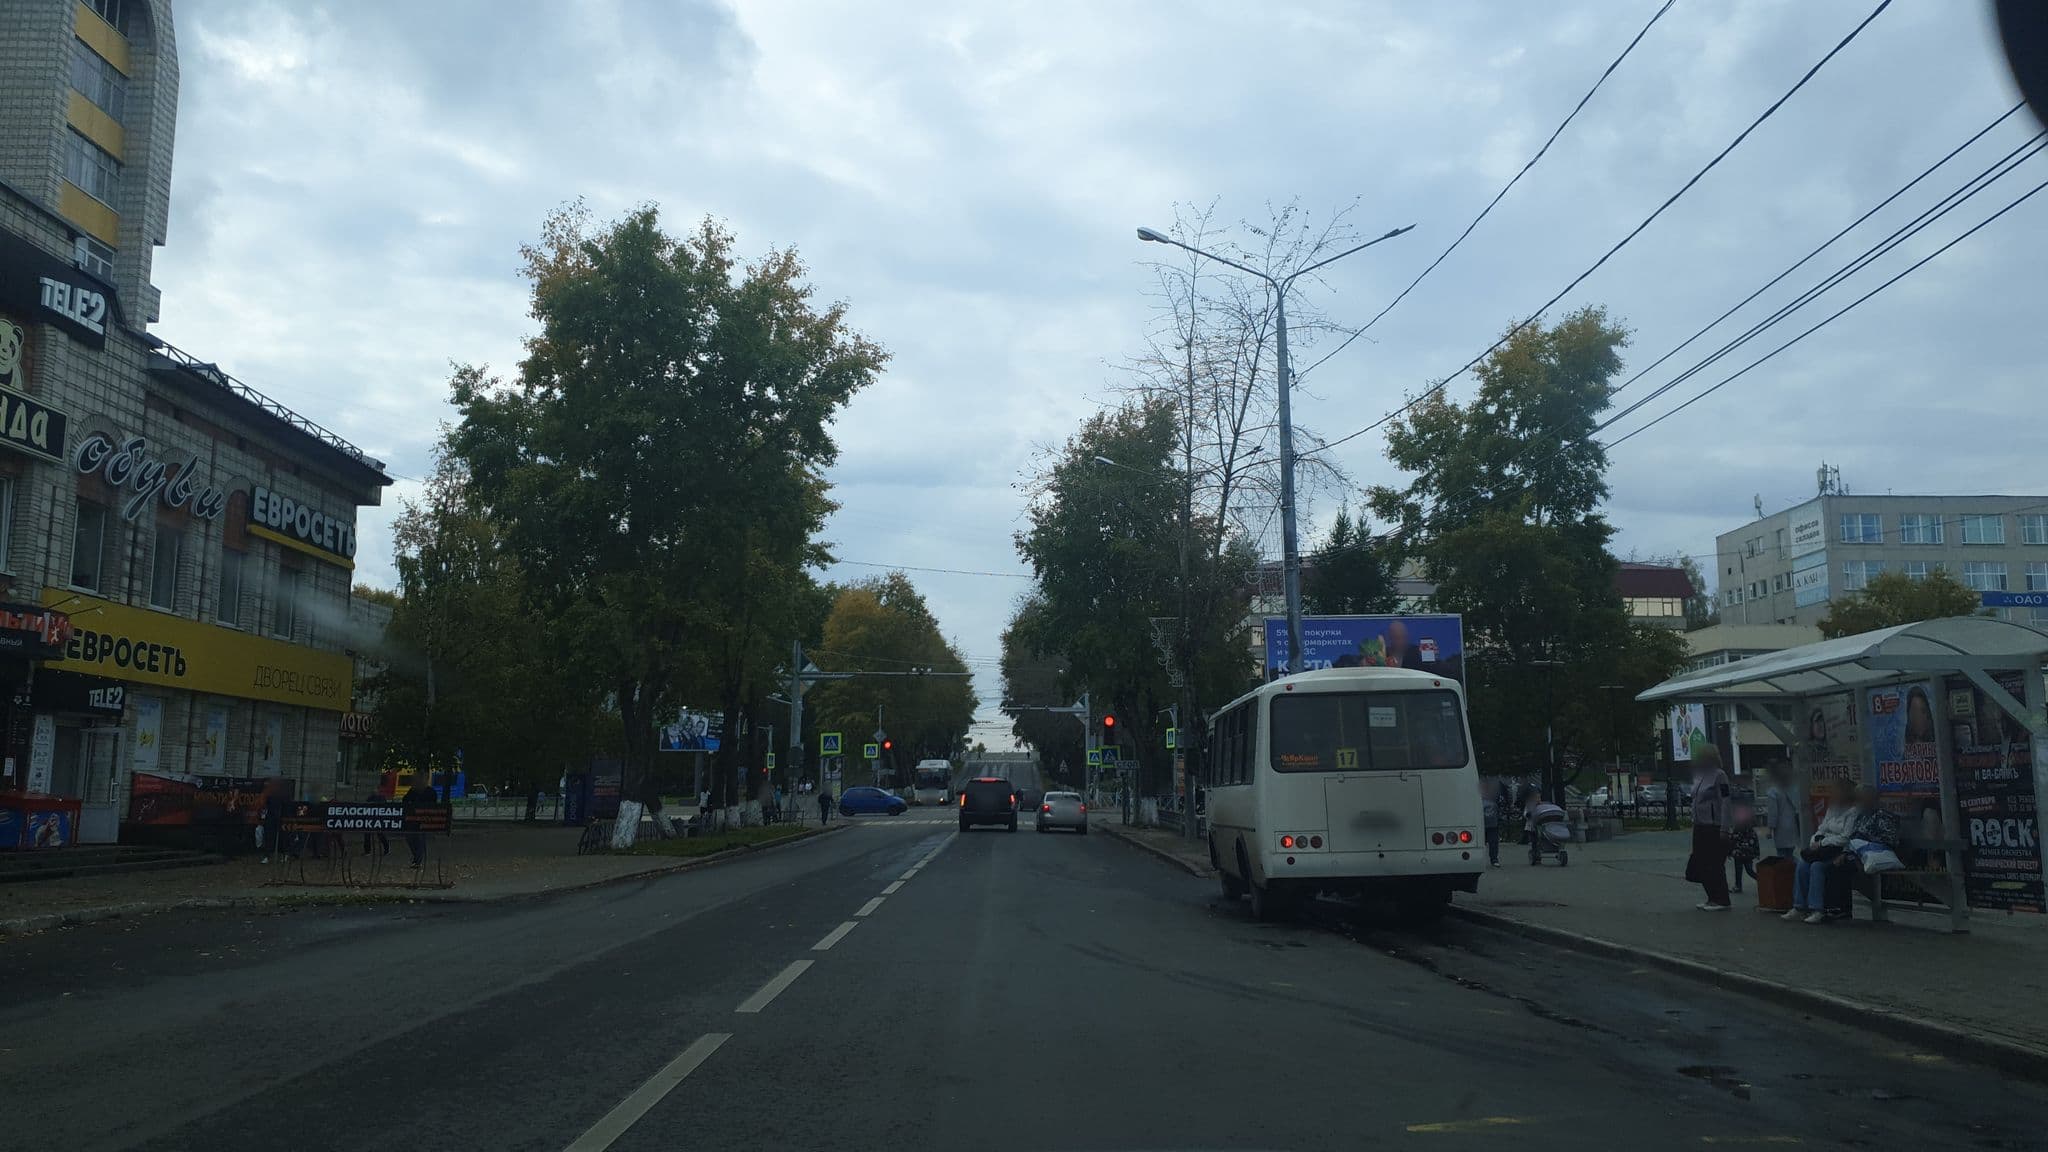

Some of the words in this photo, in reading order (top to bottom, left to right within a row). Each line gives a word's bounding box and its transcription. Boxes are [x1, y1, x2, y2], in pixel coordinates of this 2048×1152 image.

[39, 276, 106, 336] TELE2
[77, 436, 225, 520] обуви
[252, 485, 357, 557] ЕВРОСЕТЬ
[2015, 595, 2042, 604] ОАО
[1304, 629, 1342, 638] покупки
[66, 628, 187, 677] ЕВРОСЕТЬ
[253, 665, 304, 694] ДВОРЕЦ
[89, 686, 123, 709] TELE2
[1340, 752, 1355, 765] 17
[326, 819, 402, 829] САМОКАТЫ
[327, 806, 403, 816] ВЕЛОСИПЕДЫ
[1970, 818, 2034, 848] ROCK
